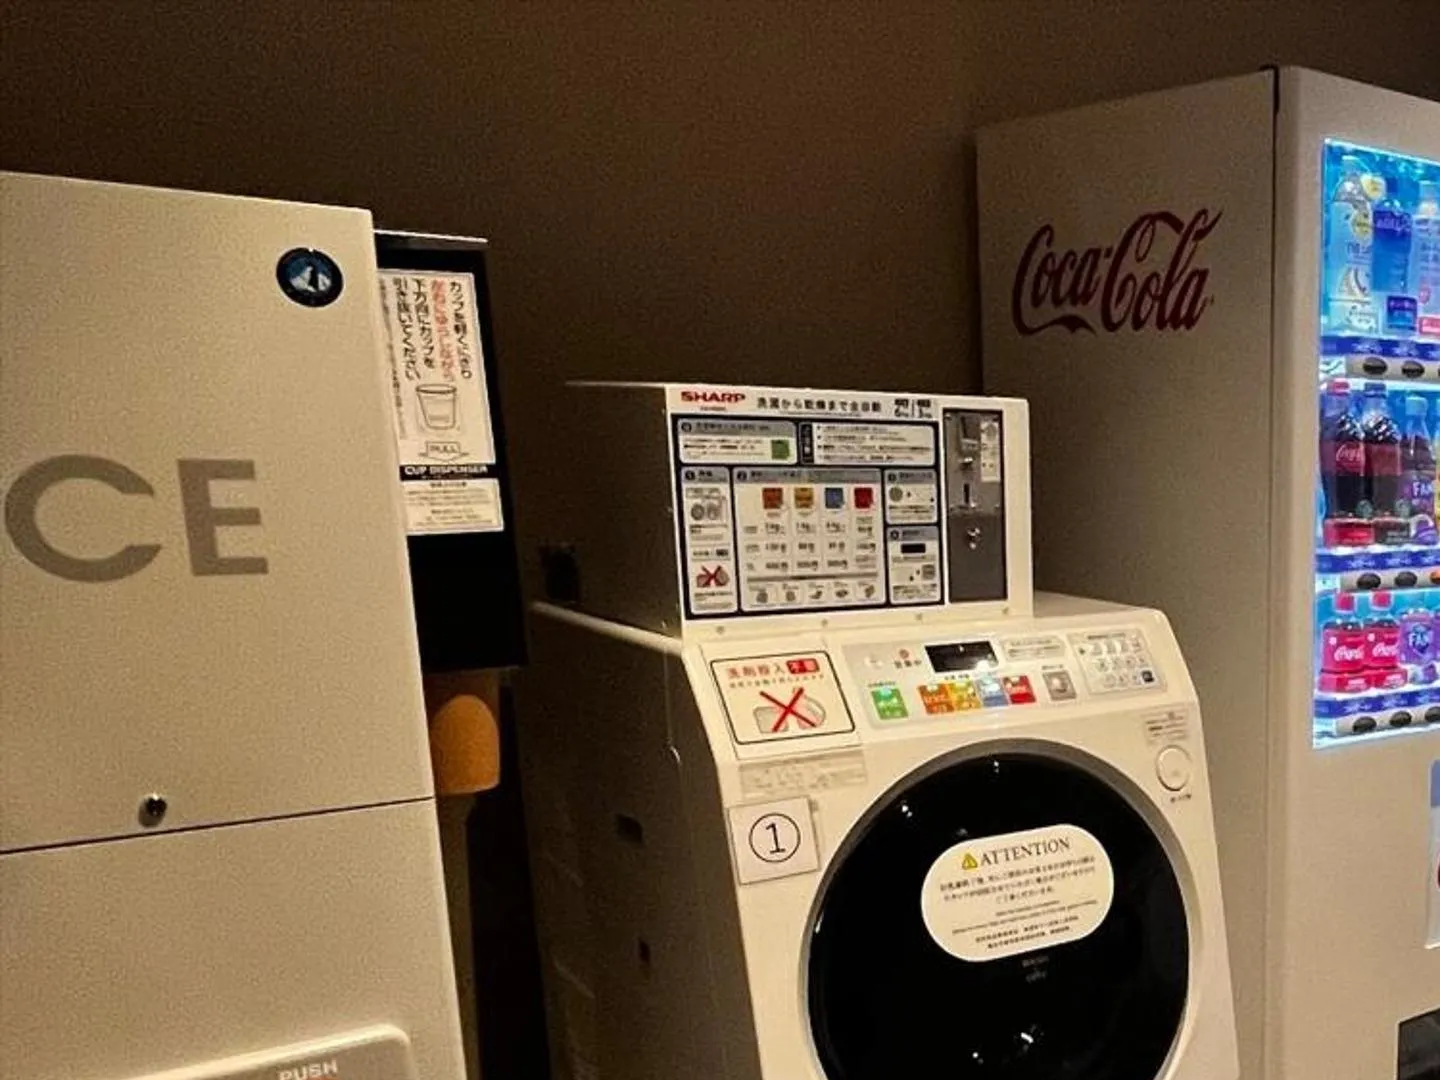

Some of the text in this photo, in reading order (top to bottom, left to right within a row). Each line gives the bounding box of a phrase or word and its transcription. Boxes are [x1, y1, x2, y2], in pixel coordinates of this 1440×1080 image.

[1012, 208, 1224, 336] Coca-Cola
[680, 391, 746, 404] SHARP
[404, 466, 427, 475] CUP
[980, 837, 1072, 867] ATTENTION
